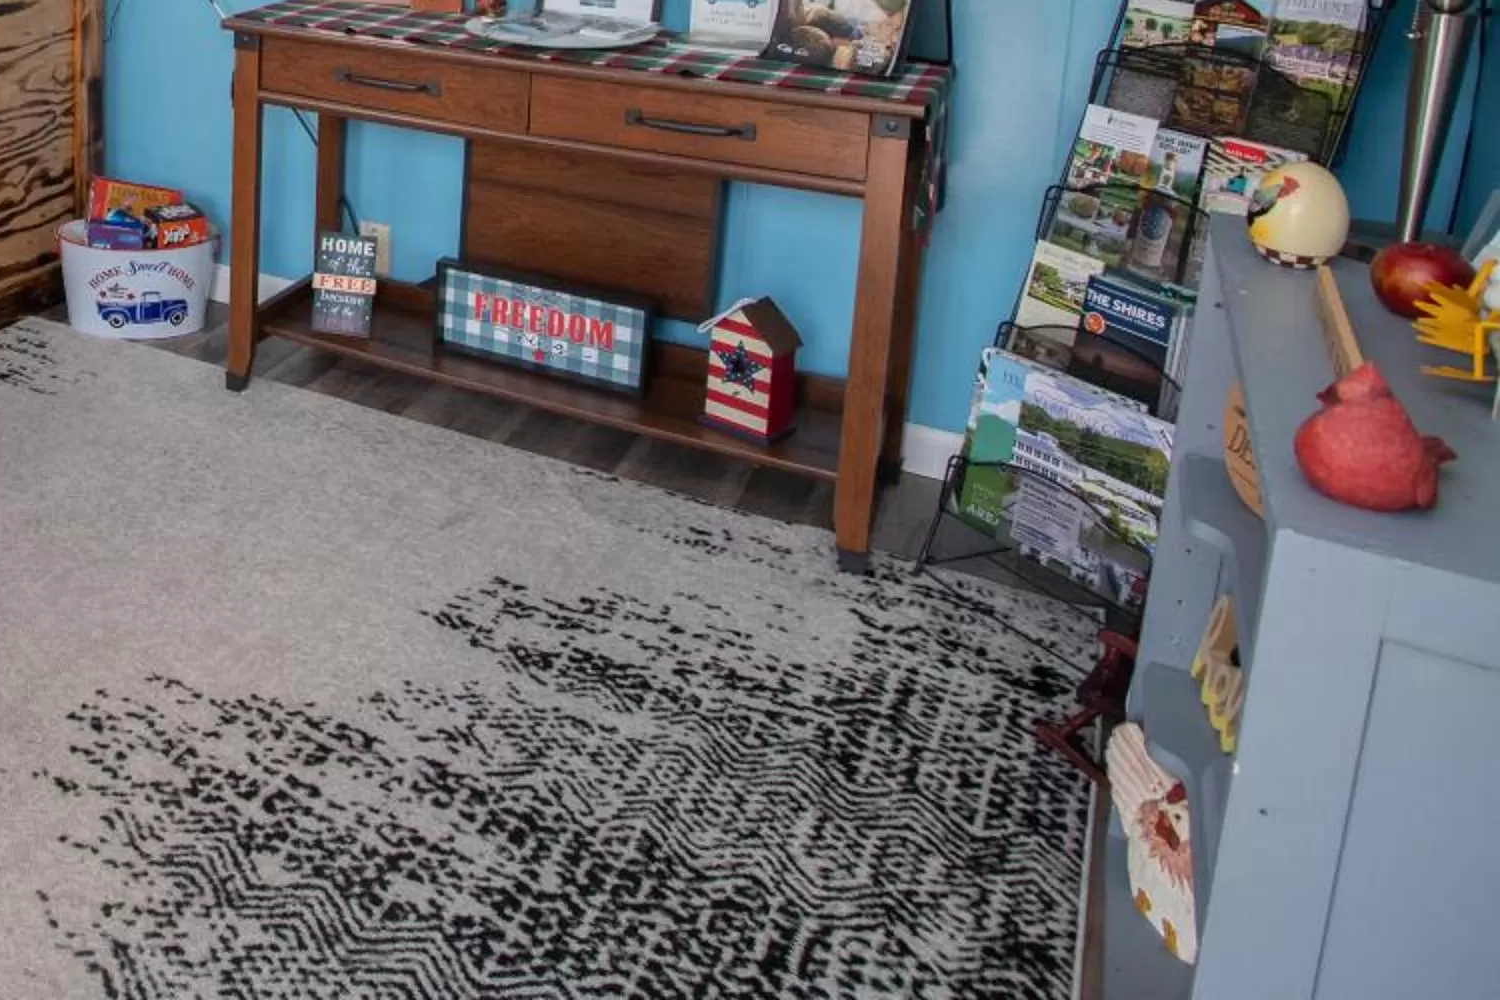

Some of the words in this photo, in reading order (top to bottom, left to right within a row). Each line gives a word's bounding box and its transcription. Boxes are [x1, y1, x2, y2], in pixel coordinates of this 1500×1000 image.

[320, 237, 376, 257] HOME
[88, 265, 122, 290] HOME
[169, 265, 196, 290] HOME
[473, 291, 616, 352] FREEDOM
[1086, 287, 1112, 308] THE
[1112, 299, 1166, 329] SHIRES
